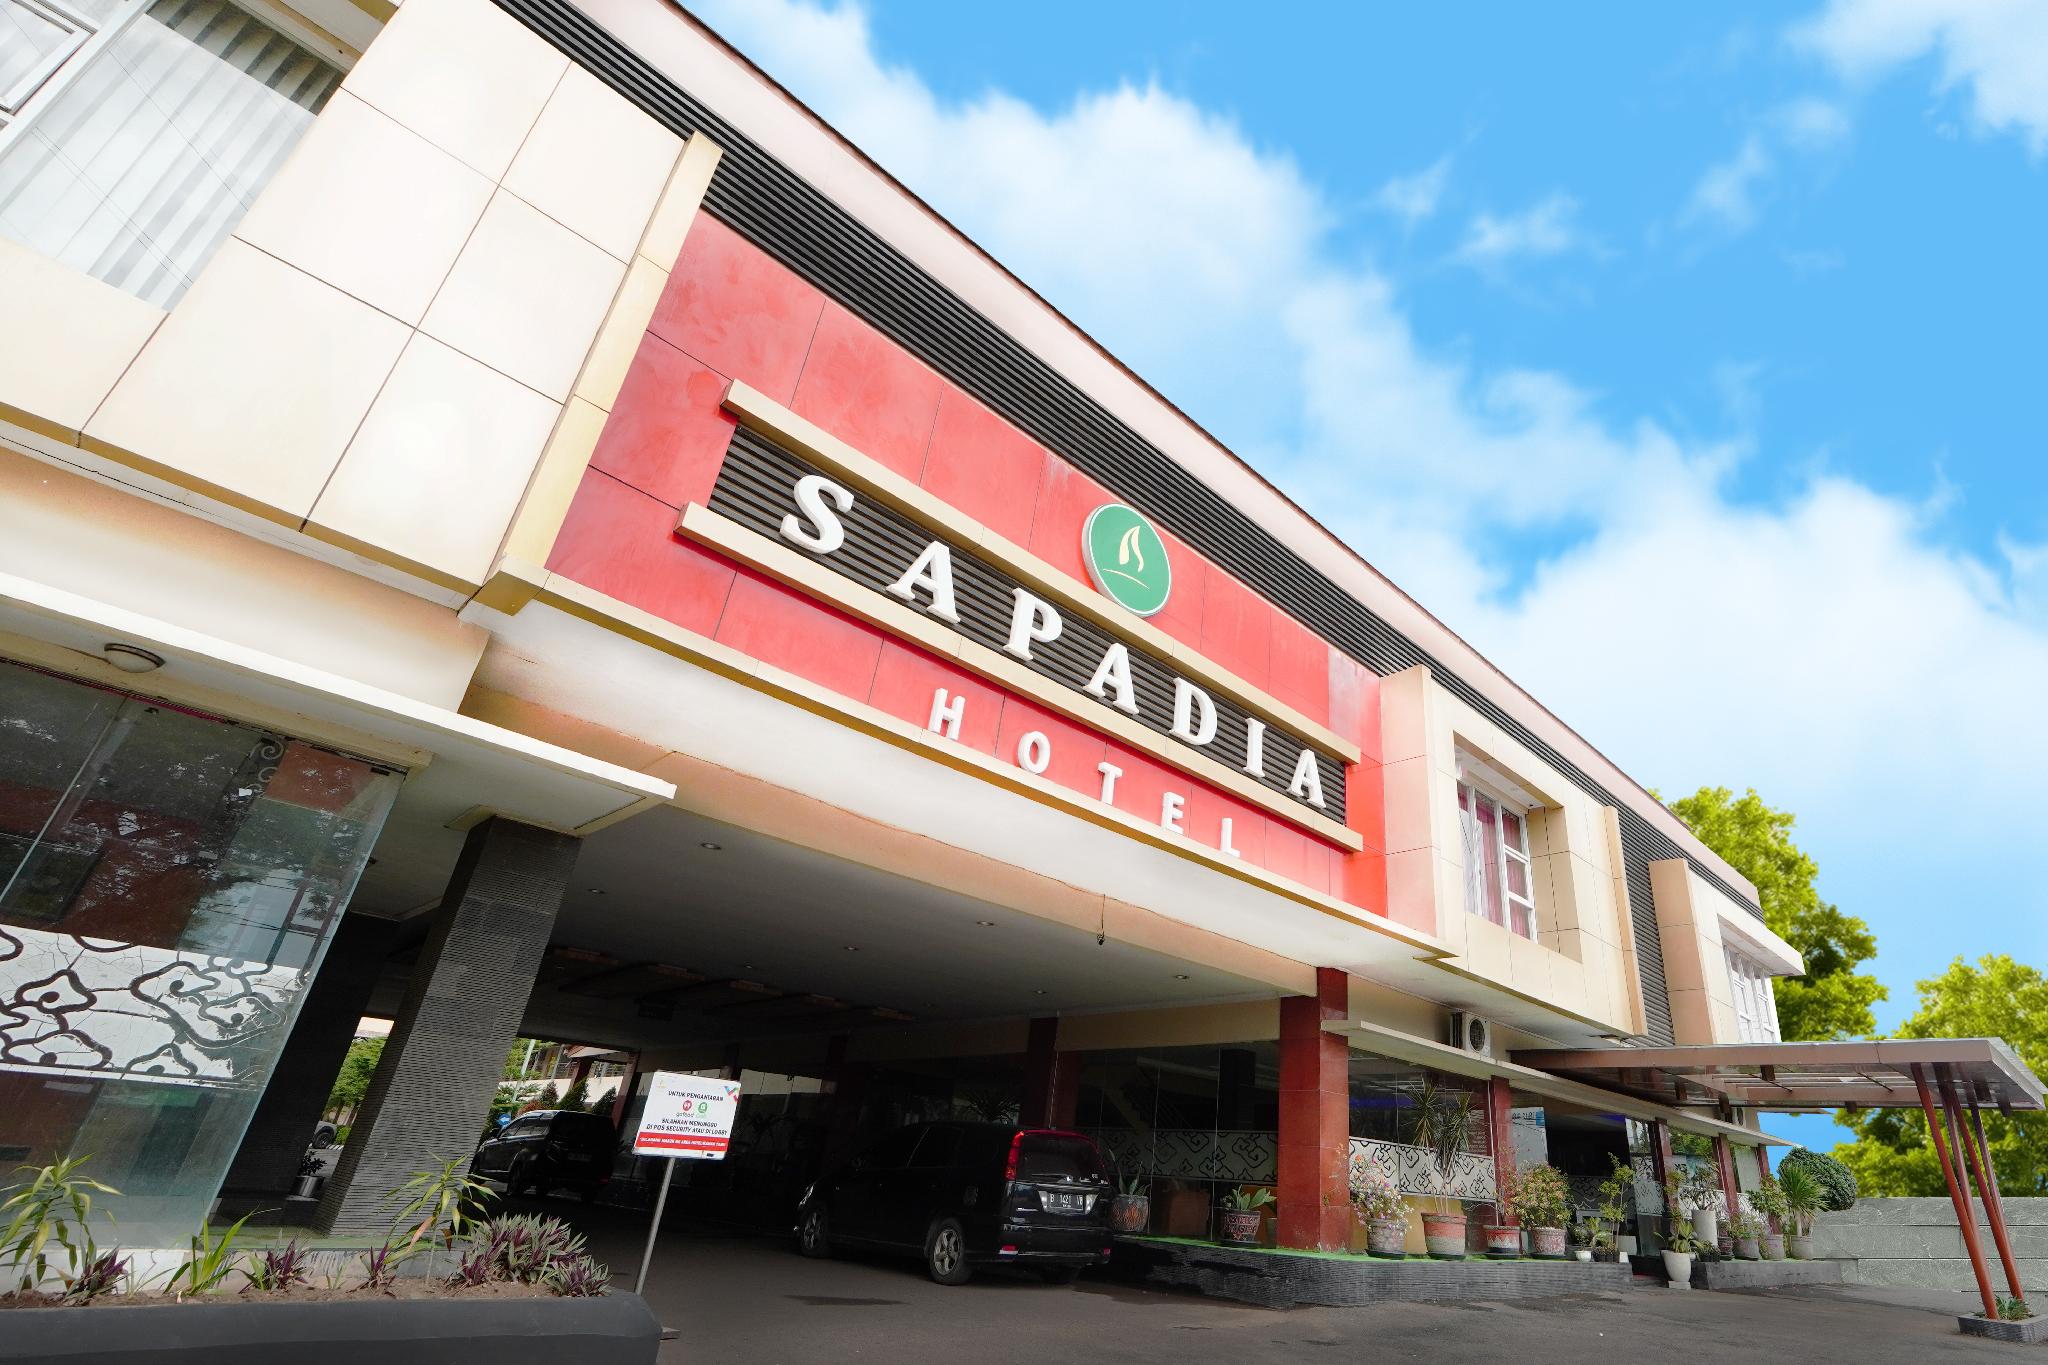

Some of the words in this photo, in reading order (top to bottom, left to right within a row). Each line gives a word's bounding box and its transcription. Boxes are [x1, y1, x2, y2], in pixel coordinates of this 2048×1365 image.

[780, 474, 1327, 809] SAPADIA
[928, 688, 1241, 858] HOTEL
[668, 1090, 686, 1098] UNTUK
[686, 1092, 724, 1101] PENGANTARAN
[665, 1125, 691, 1133] SECURITY
[1050, 1193, 1055, 1203] B
